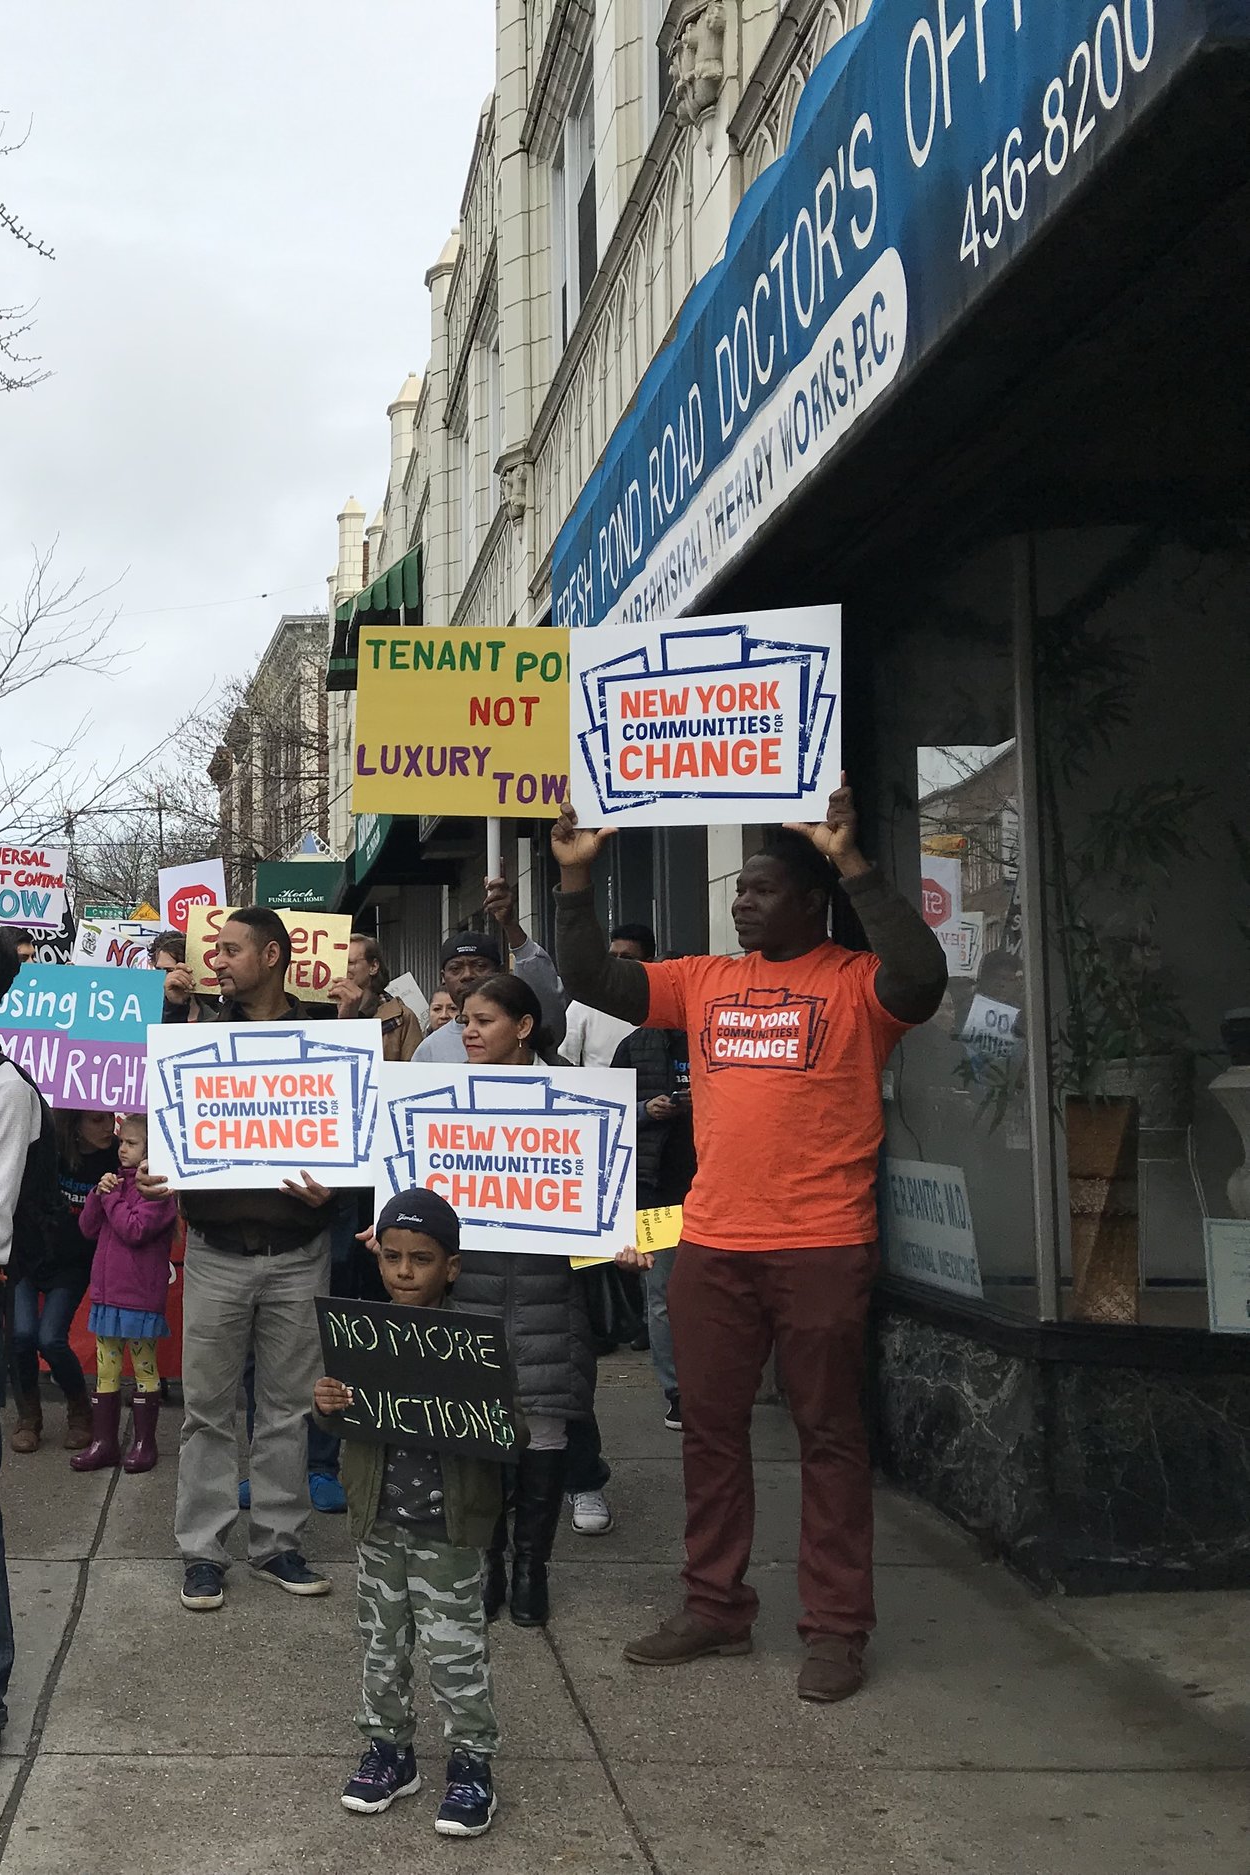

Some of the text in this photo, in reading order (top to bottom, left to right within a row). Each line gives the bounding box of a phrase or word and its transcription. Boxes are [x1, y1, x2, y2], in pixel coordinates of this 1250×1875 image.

[960, 0, 1154, 268] 456-8200
[599, 479, 643, 603] POND
[649, 383, 704, 536] ROAD
[715, 113, 877, 442] DOCTOR'S
[904, 0, 1022, 168] OFF
[705, 427, 773, 557] THERAPY
[366, 639, 570, 683] TENANT PO
[469, 696, 540, 726] NOT
[620, 680, 781, 719] NEW YORK
[622, 713, 783, 741] COMMUNITIES FOR
[356, 743, 492, 777] LUXURY
[619, 737, 782, 781] CHANGE
[14, 870, 67, 888] CONTROL
[278, 889, 313, 897] Koch
[120, 994, 142, 1022] A
[718, 1011, 801, 1028] NEW YORK
[715, 1038, 799, 1058] CHANGE
[716, 1028, 792, 1038] COMMUNITIES
[195, 1074, 335, 1099] NEW YORK
[197, 1100, 328, 1118] COMMUNITIES
[194, 1119, 339, 1151] CHANGE
[427, 1124, 582, 1156] NEW YORK
[429, 1153, 583, 1176] COMMUNITIES FOR
[425, 1172, 583, 1213] CHANGE
[327, 1311, 500, 1368] NO MORE
